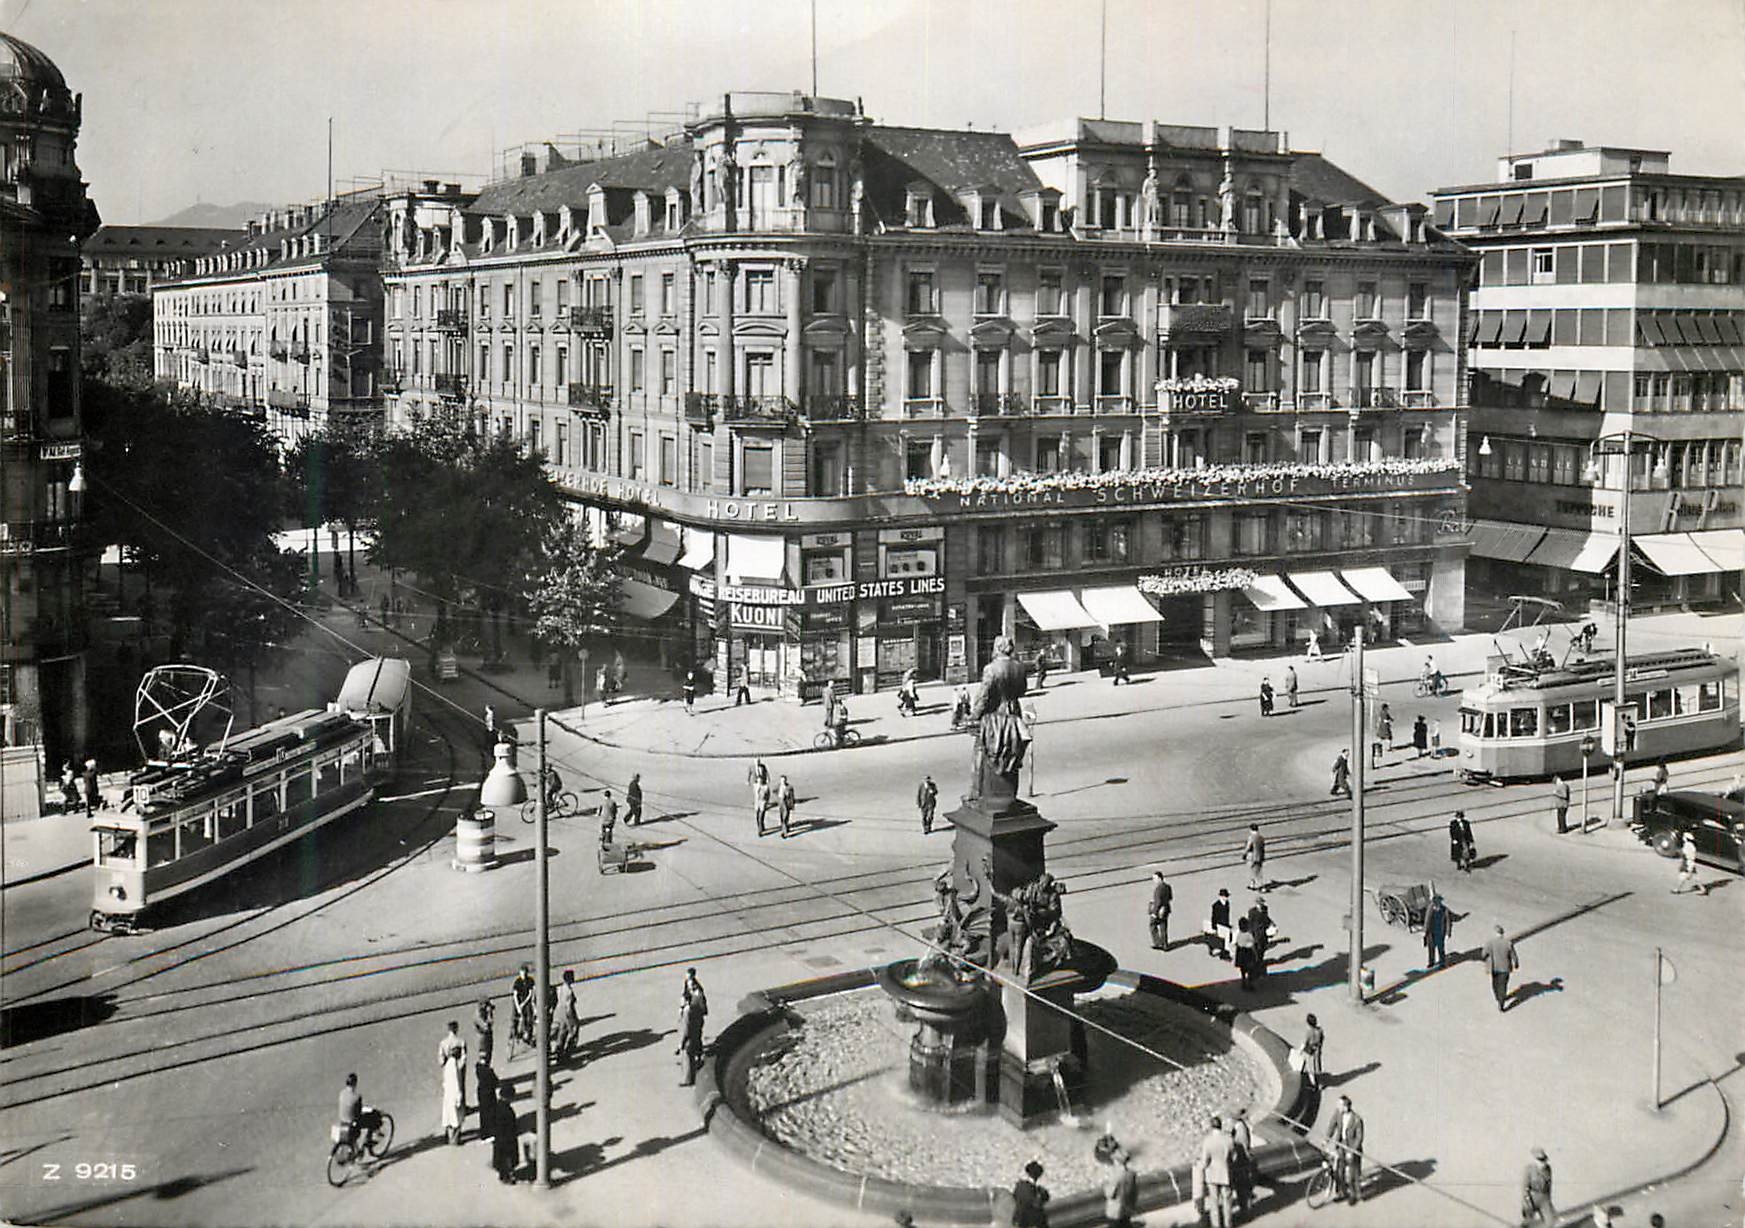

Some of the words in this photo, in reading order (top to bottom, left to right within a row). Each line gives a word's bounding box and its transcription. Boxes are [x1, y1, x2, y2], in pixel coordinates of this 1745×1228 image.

[1173, 394, 1228, 408] HOTEL
[960, 491, 1064, 506] NATIONAL
[1097, 478, 1299, 502] SCHWEIZERHOF
[1332, 474, 1414, 488] TERMINUS
[707, 500, 799, 521] HOTEL
[718, 586, 805, 605] REISEBUREAU
[816, 585, 856, 604] UNITED
[859, 580, 905, 599] STATES
[910, 577, 946, 595] LINES
[731, 602, 783, 626] KUONI
[135, 787, 148, 803] 10
